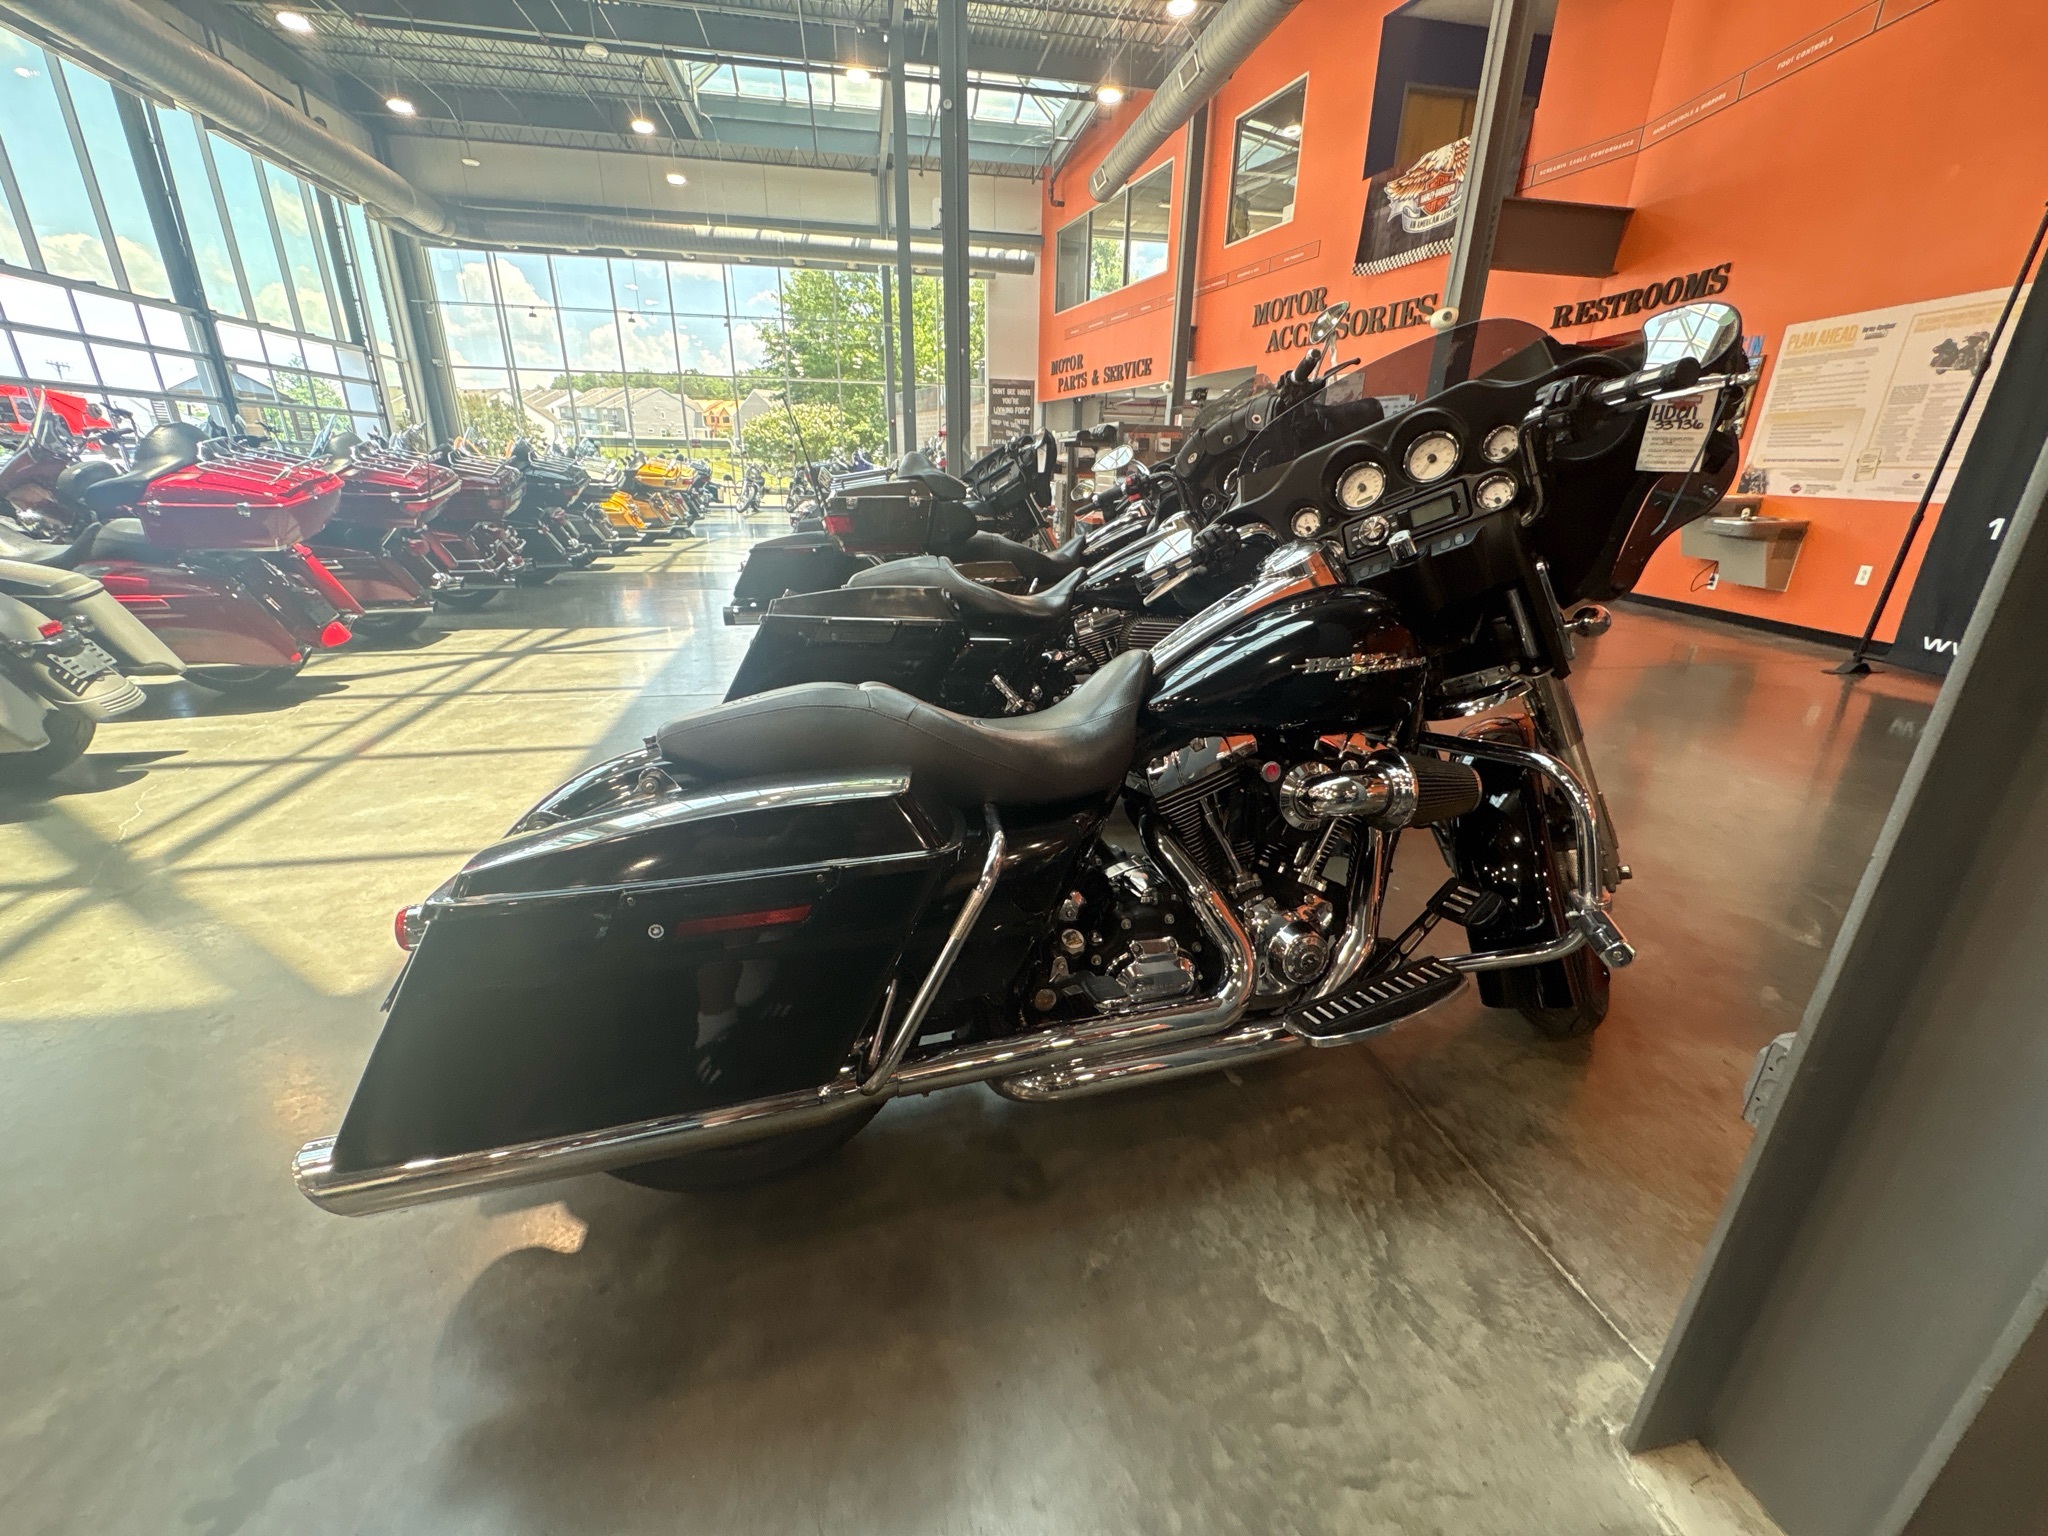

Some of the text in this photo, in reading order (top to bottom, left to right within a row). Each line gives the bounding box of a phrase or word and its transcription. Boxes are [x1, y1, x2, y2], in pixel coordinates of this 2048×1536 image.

[1795, 35, 1834, 61] CONTROLS
[1590, 138, 1634, 159] PERFORMANCE
[1252, 286, 1328, 328] MOTOR
[1549, 262, 1732, 330] RESTROOMS
[1265, 293, 1439, 353] ACCSORIES
[1786, 331, 1816, 351] PLAN
[1817, 324, 1859, 346] AHEAD
[1050, 353, 1084, 376] MOTOR
[1057, 357, 1153, 393] PARTS & SERVICE
[1006, 388, 1016, 396] SEE
[1017, 388, 1031, 396] WHAT
